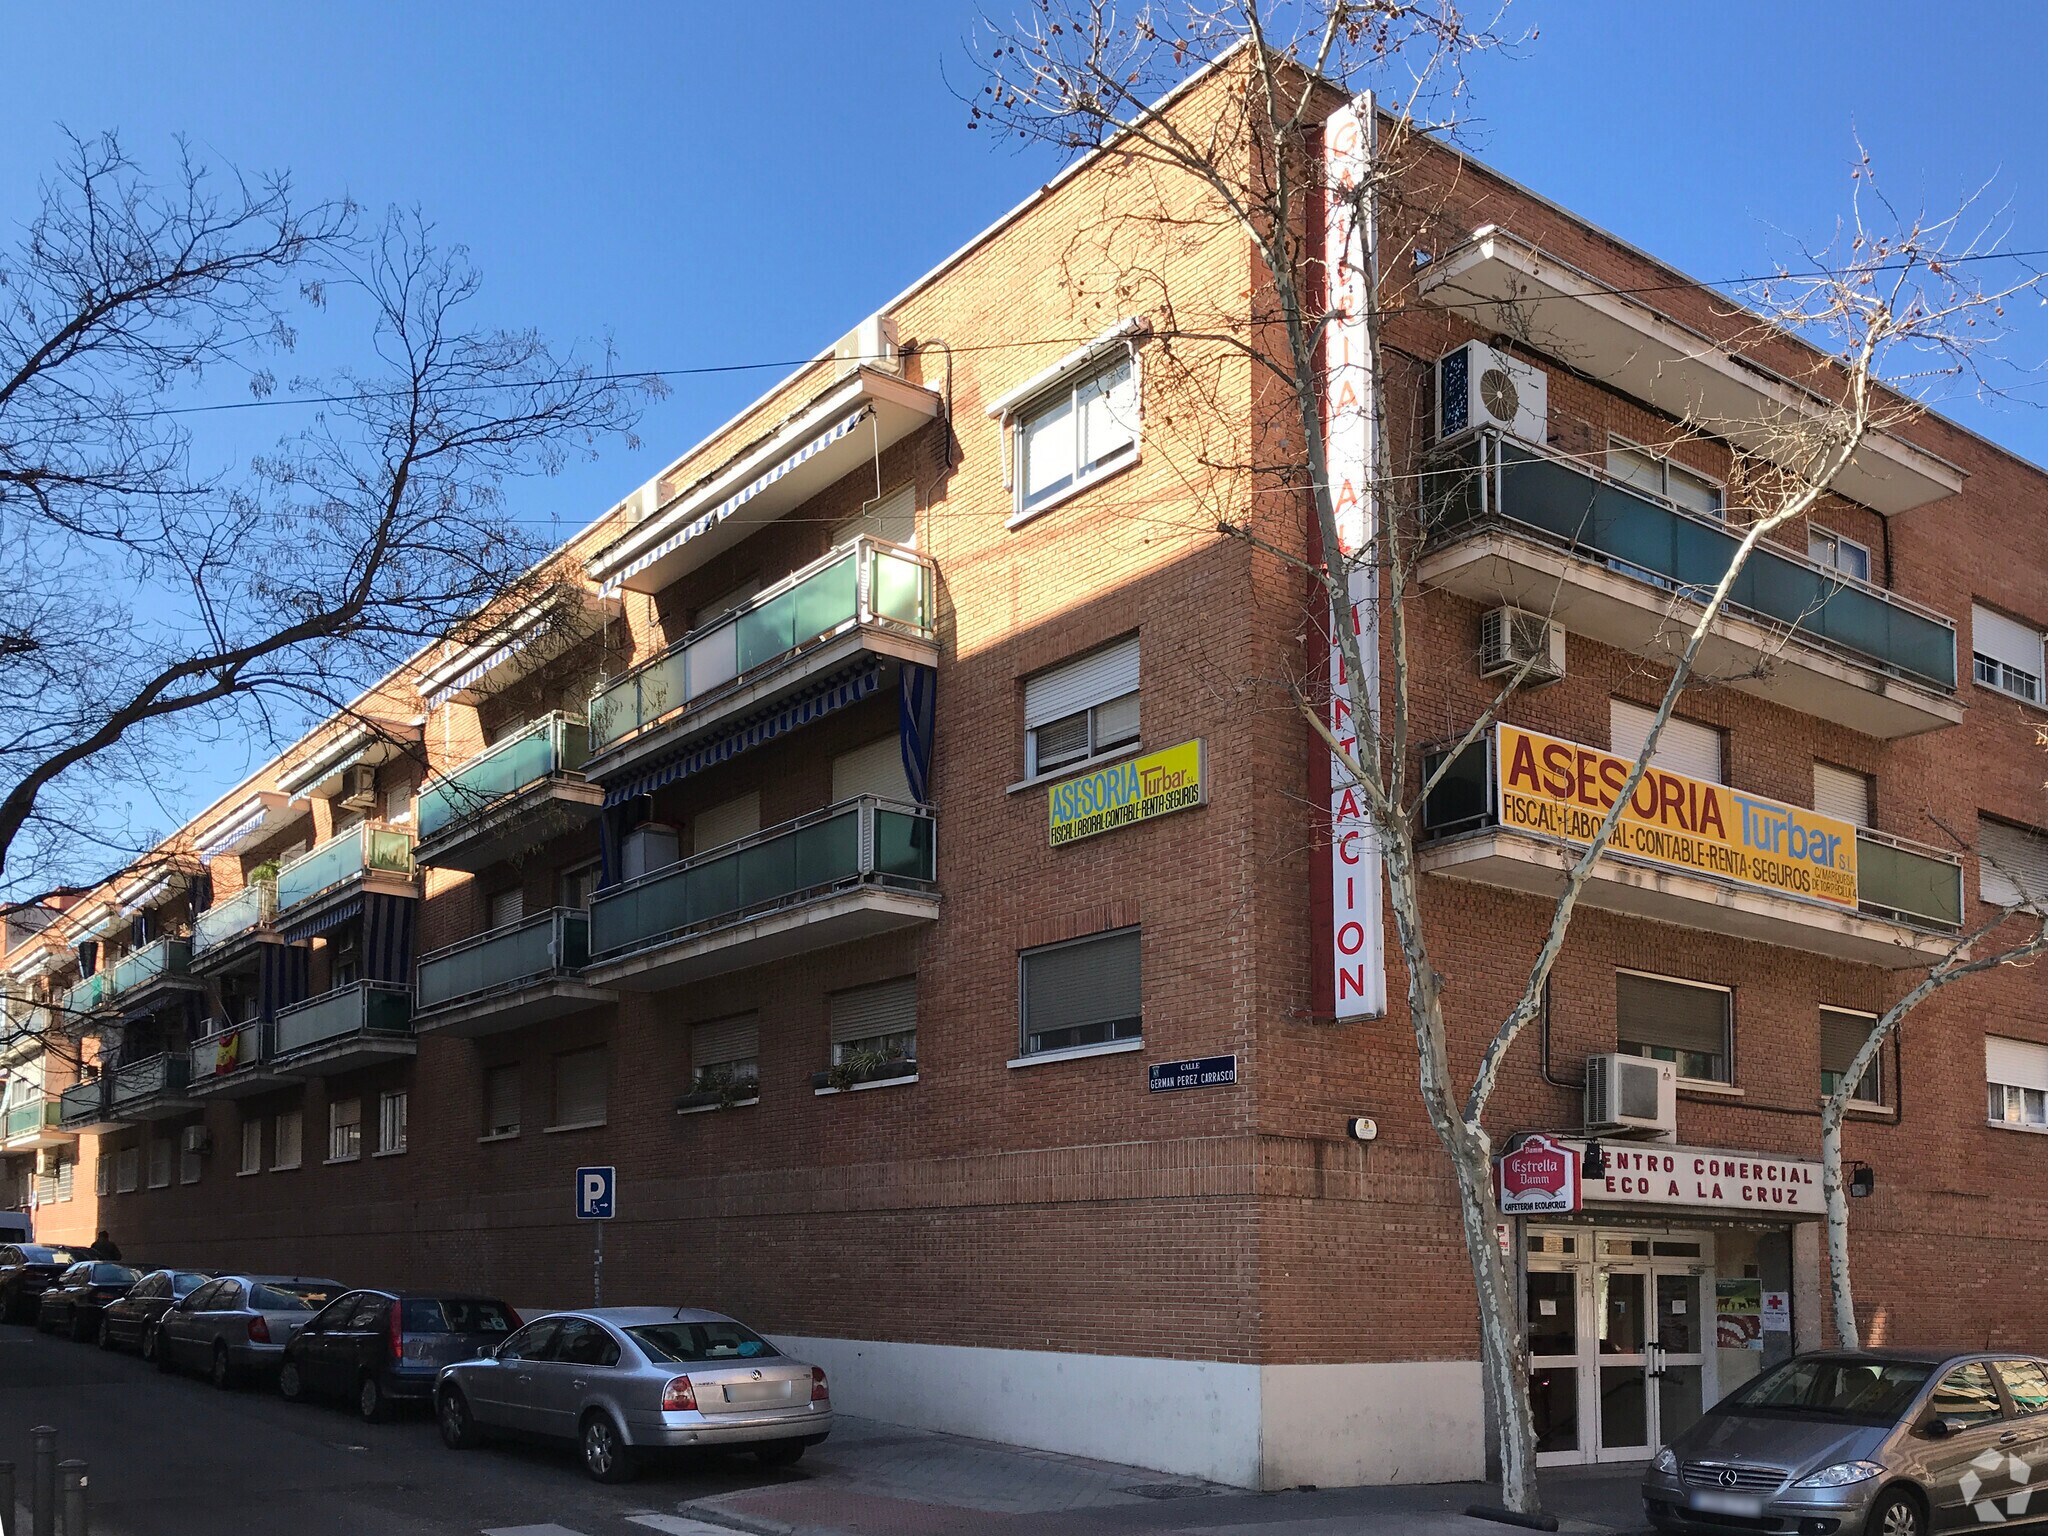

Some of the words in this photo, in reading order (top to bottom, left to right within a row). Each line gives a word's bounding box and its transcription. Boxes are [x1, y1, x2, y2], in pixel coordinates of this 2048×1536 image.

[1051, 762, 1142, 827] ASESORIA
[1140, 765, 1187, 798] Turbar
[1508, 734, 1727, 840] ASESORIA
[1733, 795, 1842, 869] Turbar
[1180, 1062, 1201, 1071] CALLE
[1150, 1077, 1175, 1090] GERMAN
[1177, 1073, 1198, 1087] PEREZ
[1200, 1069, 1234, 1084] CARRASCO
[1511, 1158, 1558, 1173] Estrella
[1601, 1151, 1675, 1173] ENTRO
[1693, 1158, 1813, 1185] COMERCIAL
[1520, 1173, 1550, 1185] Damm
[1605, 1175, 1650, 1195] ECO
[1667, 1179, 1680, 1197] A
[1697, 1182, 1723, 1200] LA
[1742, 1185, 1798, 1205] CRUZ
[1504, 1202, 1534, 1212] CAFETERIA
[1534, 1200, 1567, 1210] ECOLACRUZ
